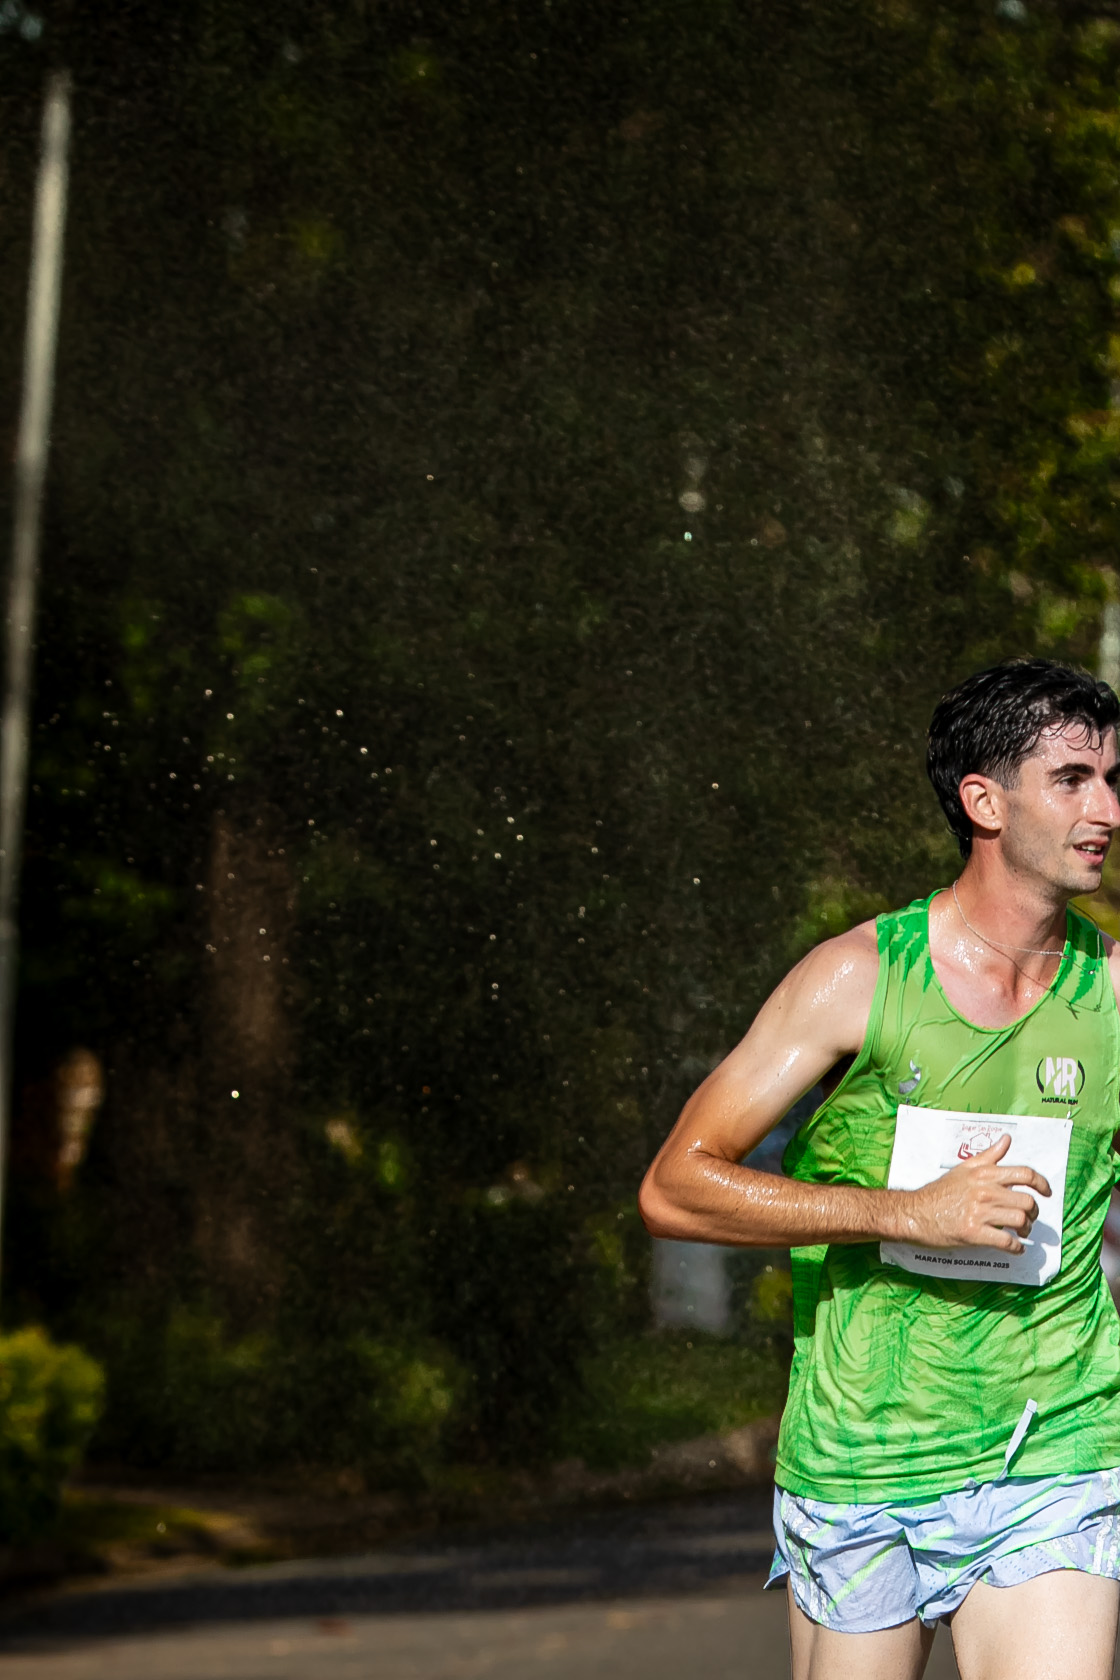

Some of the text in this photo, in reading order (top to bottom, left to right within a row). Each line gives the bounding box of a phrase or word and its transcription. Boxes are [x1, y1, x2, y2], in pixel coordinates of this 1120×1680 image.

[1045, 1056, 1078, 1097] NR
[914, 1254, 1010, 1269] MARATON SOLIDARIA 2025
